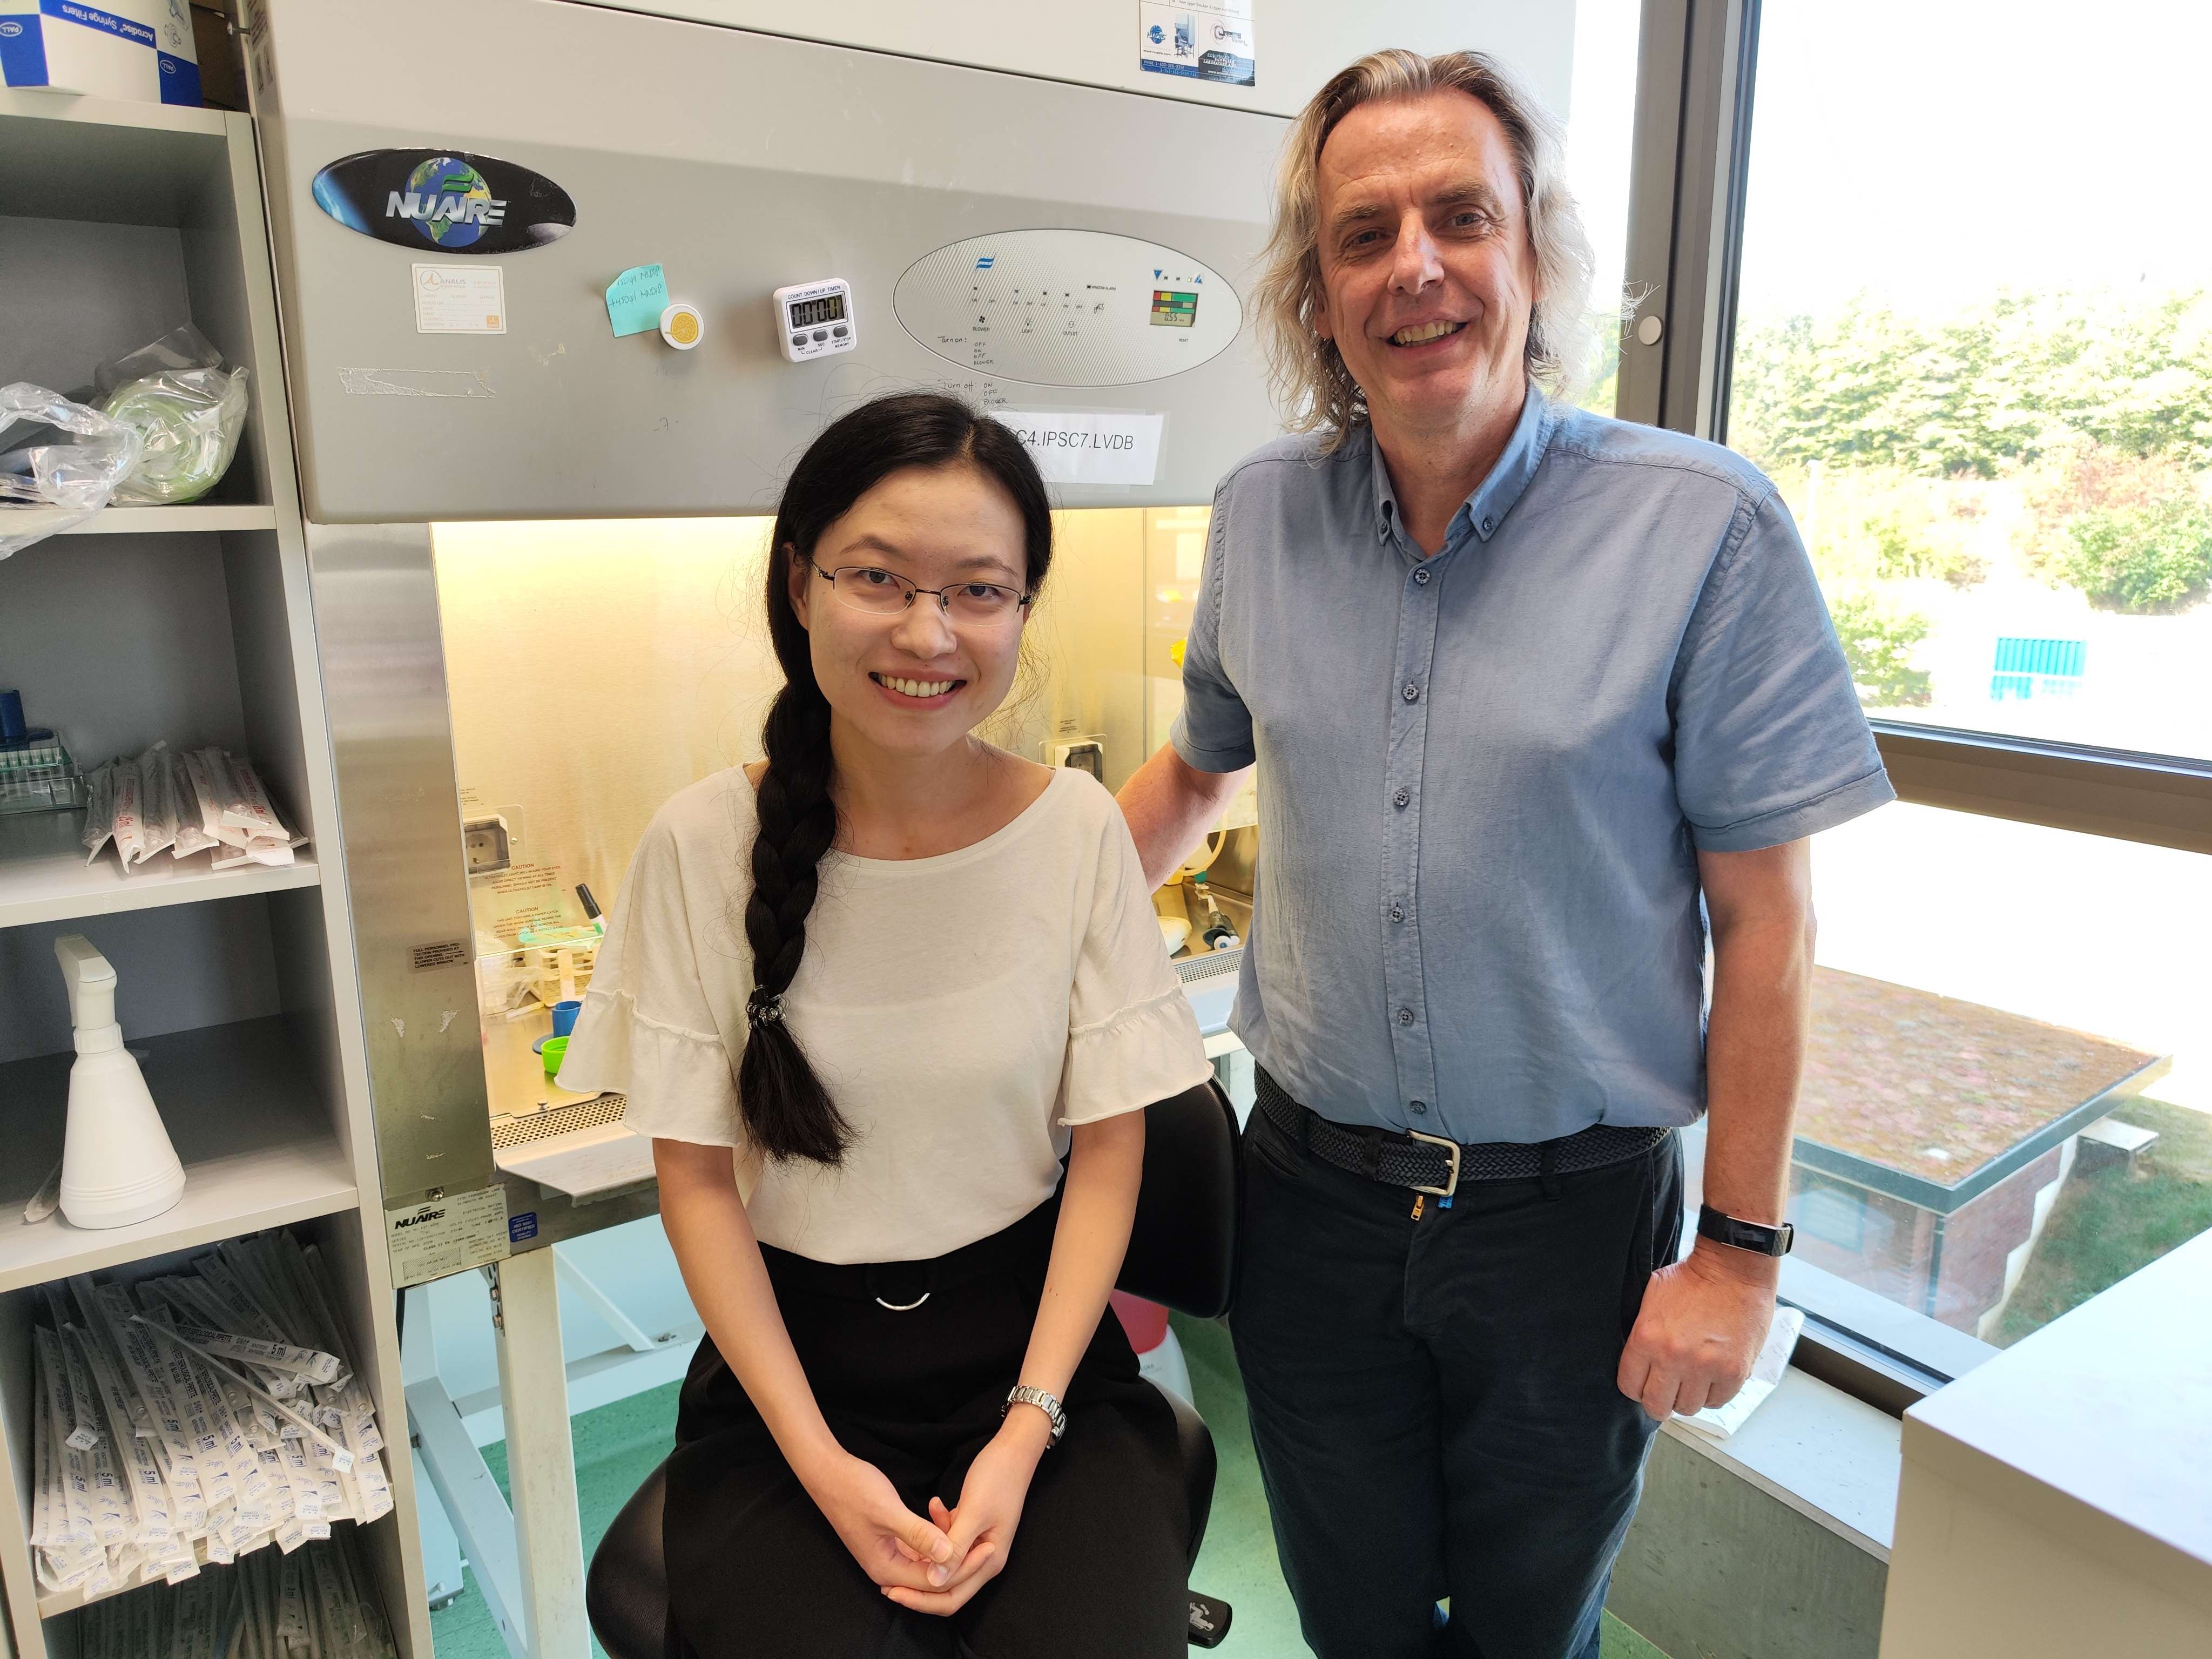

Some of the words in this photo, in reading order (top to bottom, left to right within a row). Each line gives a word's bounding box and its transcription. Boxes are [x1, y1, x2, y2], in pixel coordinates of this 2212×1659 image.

[62, 4, 87, 21] Filters
[89, 12, 117, 30] Syringe
[162, 63, 174, 71] PALL
[385, 190, 509, 226] NUAIRE
[394, 1209, 446, 1230] NUAIRE
[271, 1345, 276, 1355] 5
[276, 1346, 287, 1356] ml
[170, 1424, 182, 1432] ml
[231, 1435, 240, 1444] 5
[205, 1441, 218, 1451] ml
[233, 1443, 244, 1453] ml
[103, 1478, 114, 1486] ml
[145, 1475, 159, 1485] ml
[77, 1482, 87, 1493] ml
